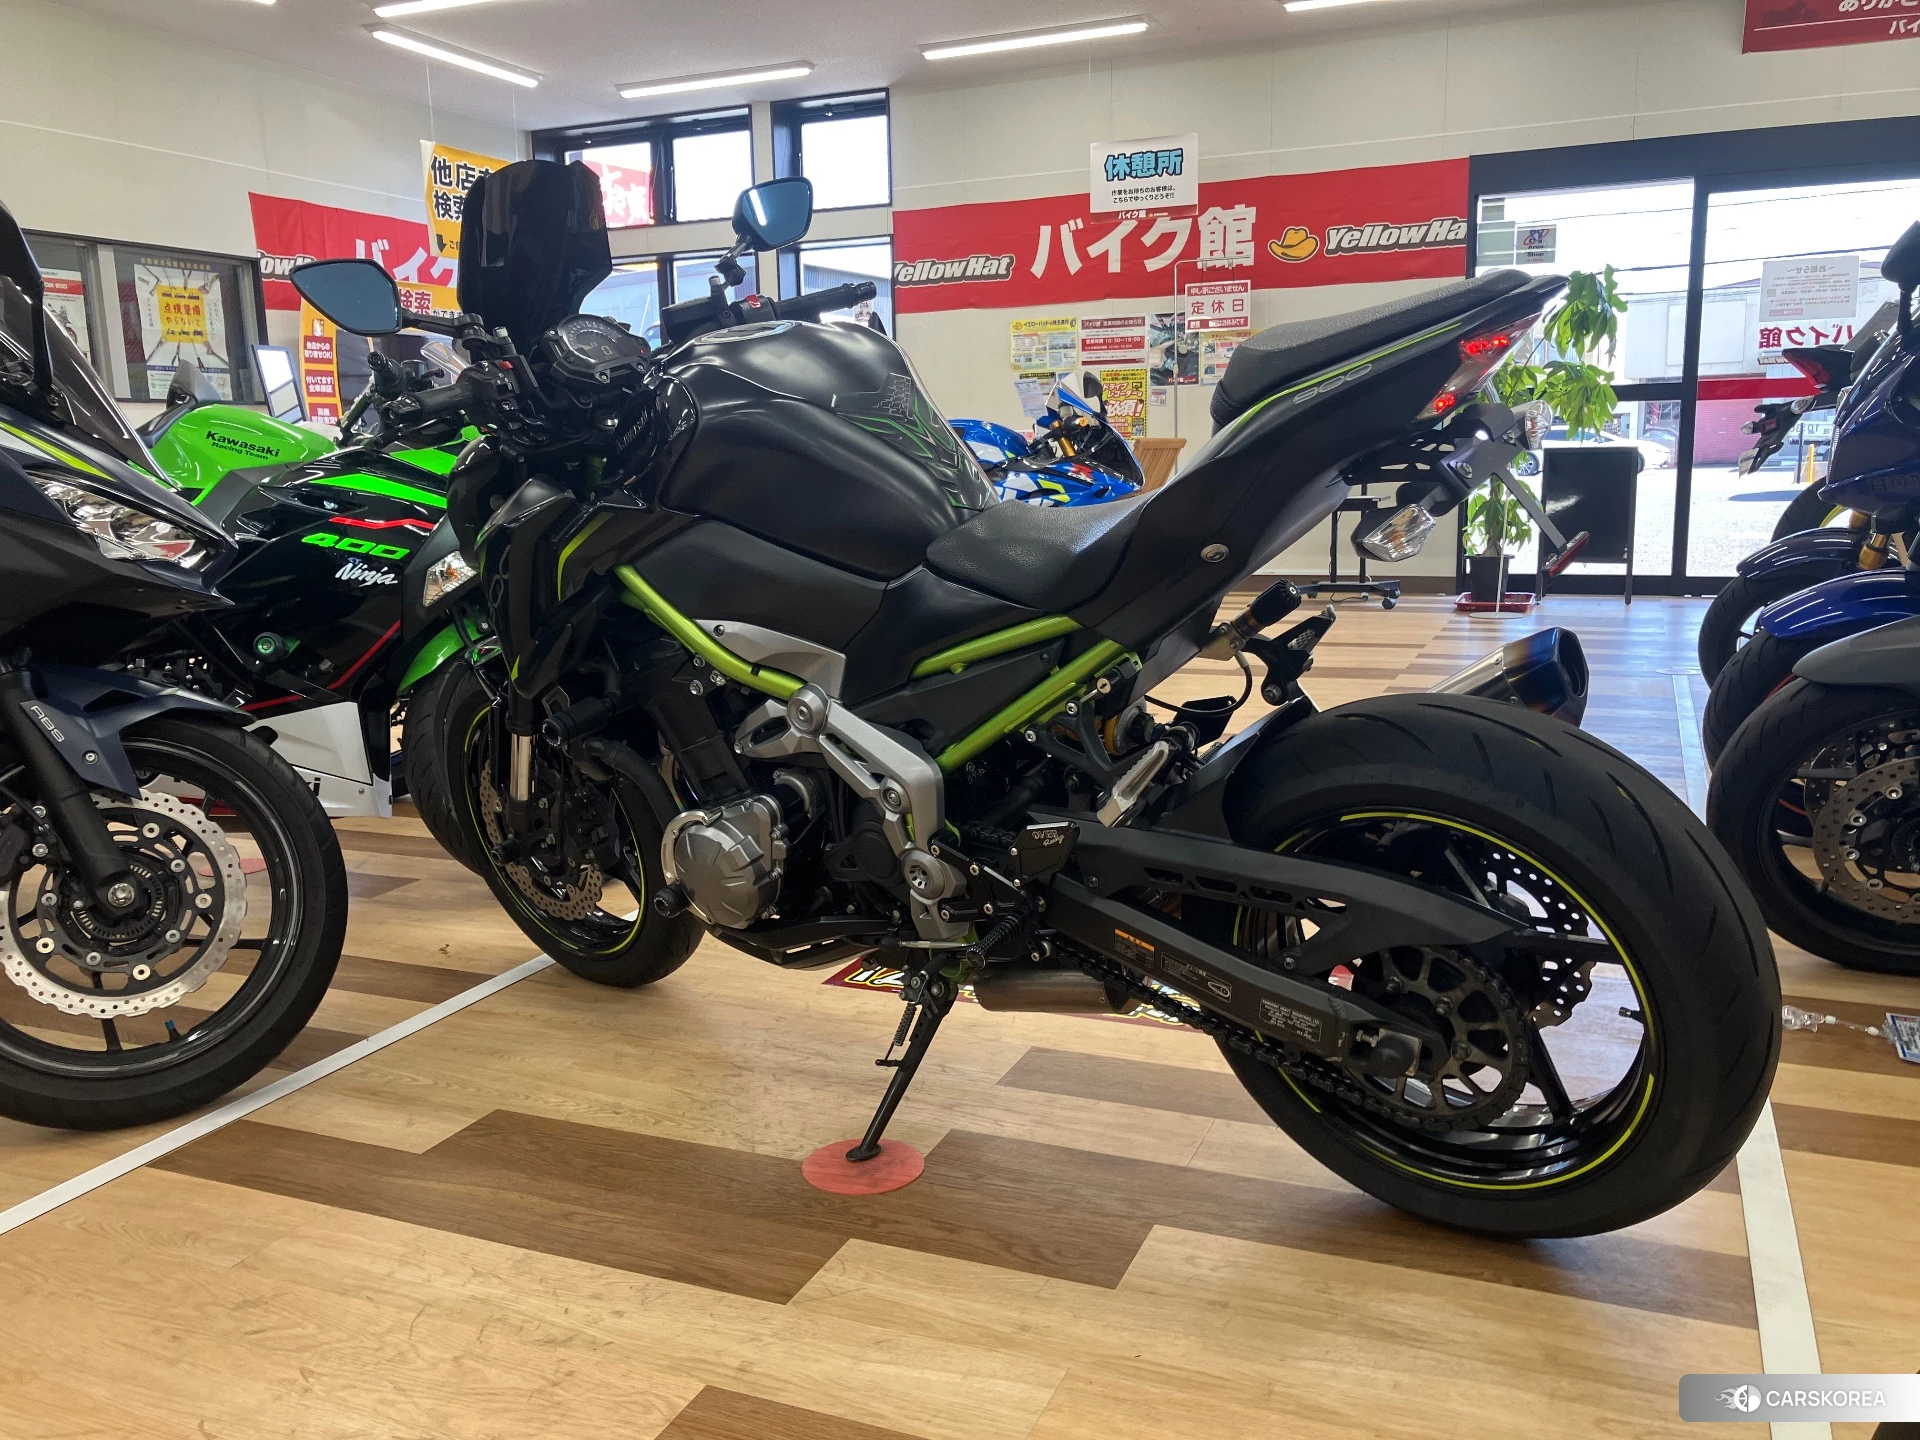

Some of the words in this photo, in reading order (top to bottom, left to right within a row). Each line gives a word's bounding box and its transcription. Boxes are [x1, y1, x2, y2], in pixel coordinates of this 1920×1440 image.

[1103, 147, 1184, 182] 休憩所
[1029, 204, 1257, 279] バイク館
[1326, 218, 1467, 251] YellowHa
[163, 303, 201, 316] 点検整備
[1190, 298, 1245, 316] 定休日
[165, 316, 201, 327] やらないと
[205, 430, 281, 458] Kawasaki
[211, 441, 243, 456] Racing
[244, 449, 270, 462] Team
[301, 532, 411, 560] 400
[335, 562, 399, 588] Ninja
[30, 705, 65, 743] ABS
